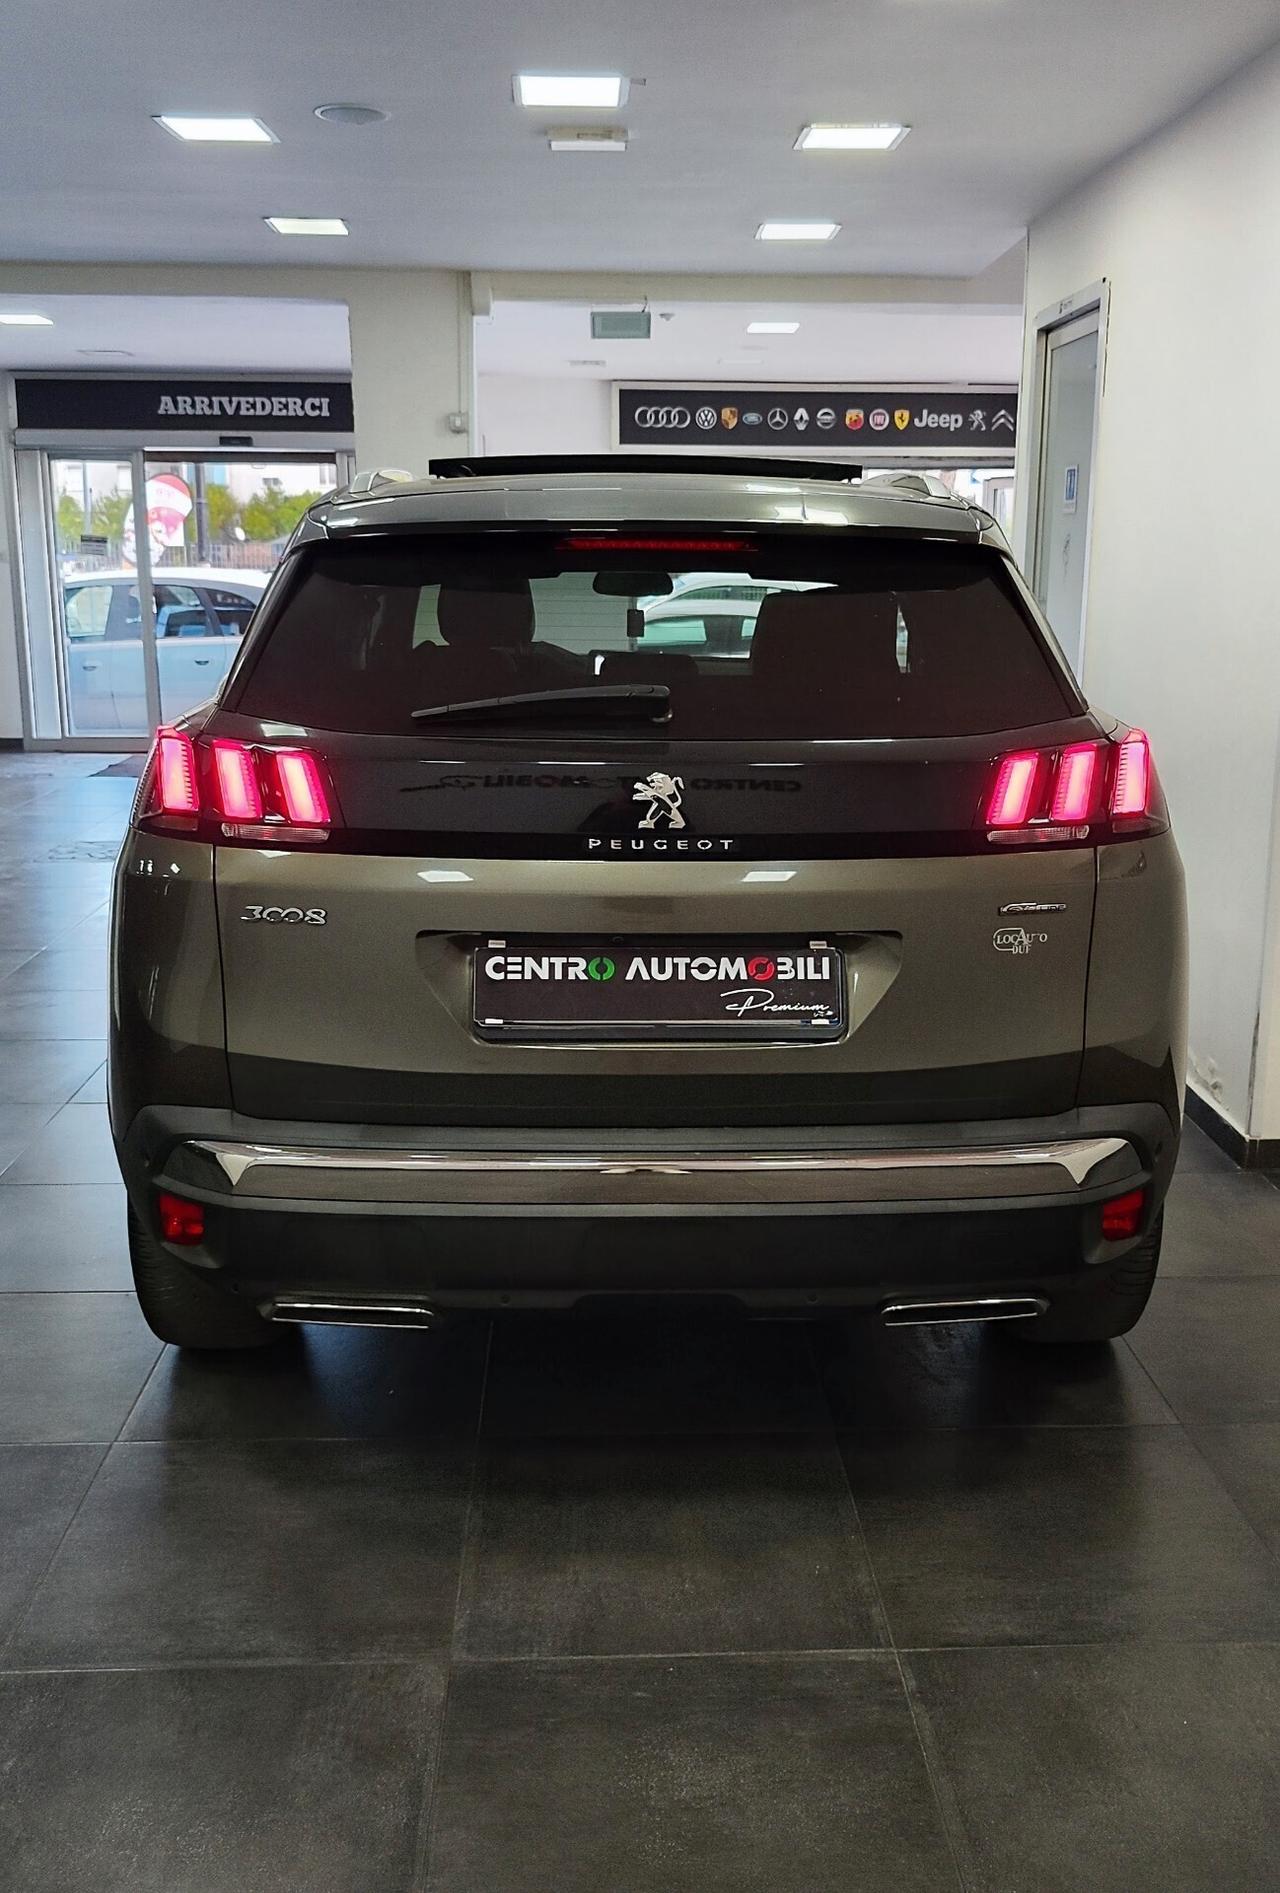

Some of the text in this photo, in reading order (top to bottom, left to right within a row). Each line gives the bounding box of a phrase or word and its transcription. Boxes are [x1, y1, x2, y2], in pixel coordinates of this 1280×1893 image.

[158, 396, 330, 417] ARRIVEDERCI
[914, 409, 963, 431] Jeep
[588, 838, 733, 850] PEUGEOT
[240, 905, 327, 924] 3008
[485, 956, 830, 981] CENTRO AUTOMOBILI
[720, 988, 829, 1017] Premium
